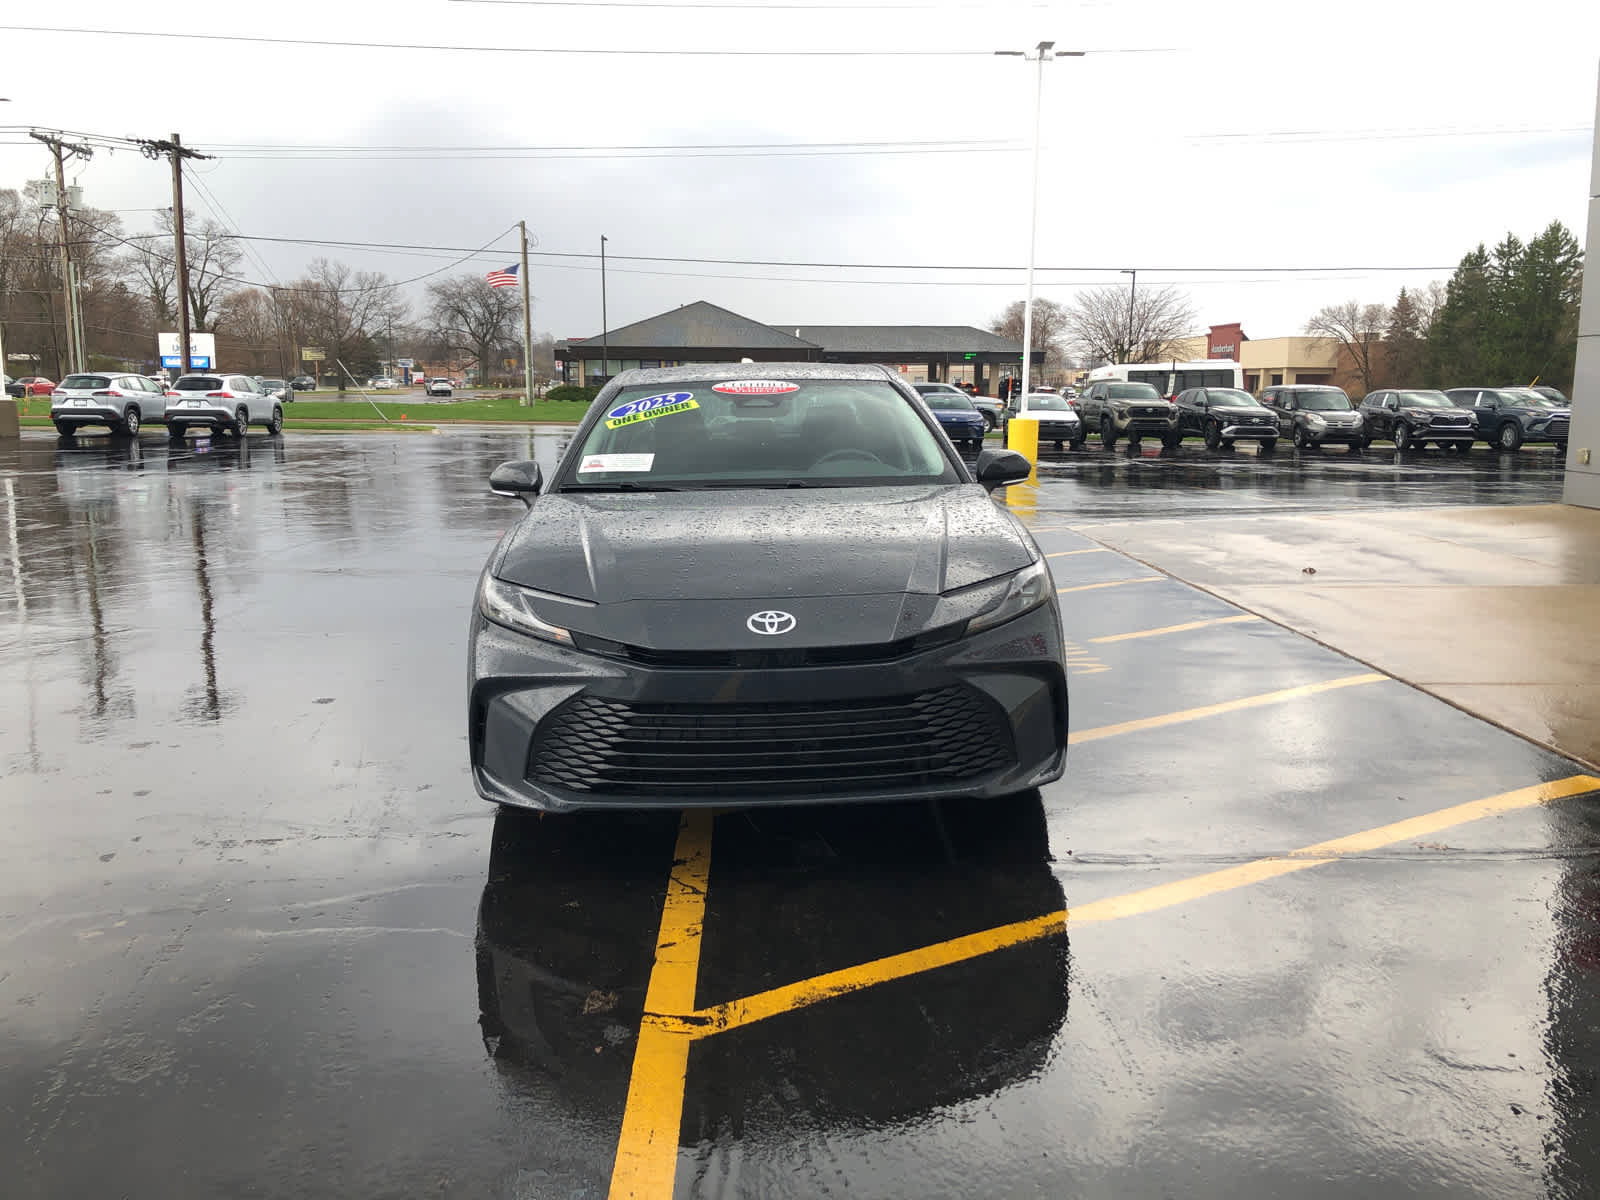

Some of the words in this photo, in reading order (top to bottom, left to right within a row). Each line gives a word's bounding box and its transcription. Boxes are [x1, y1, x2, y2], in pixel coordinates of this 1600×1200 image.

[613, 414, 640, 426] ONE
[643, 402, 690, 418] OWNER
[625, 393, 678, 416] 2025
